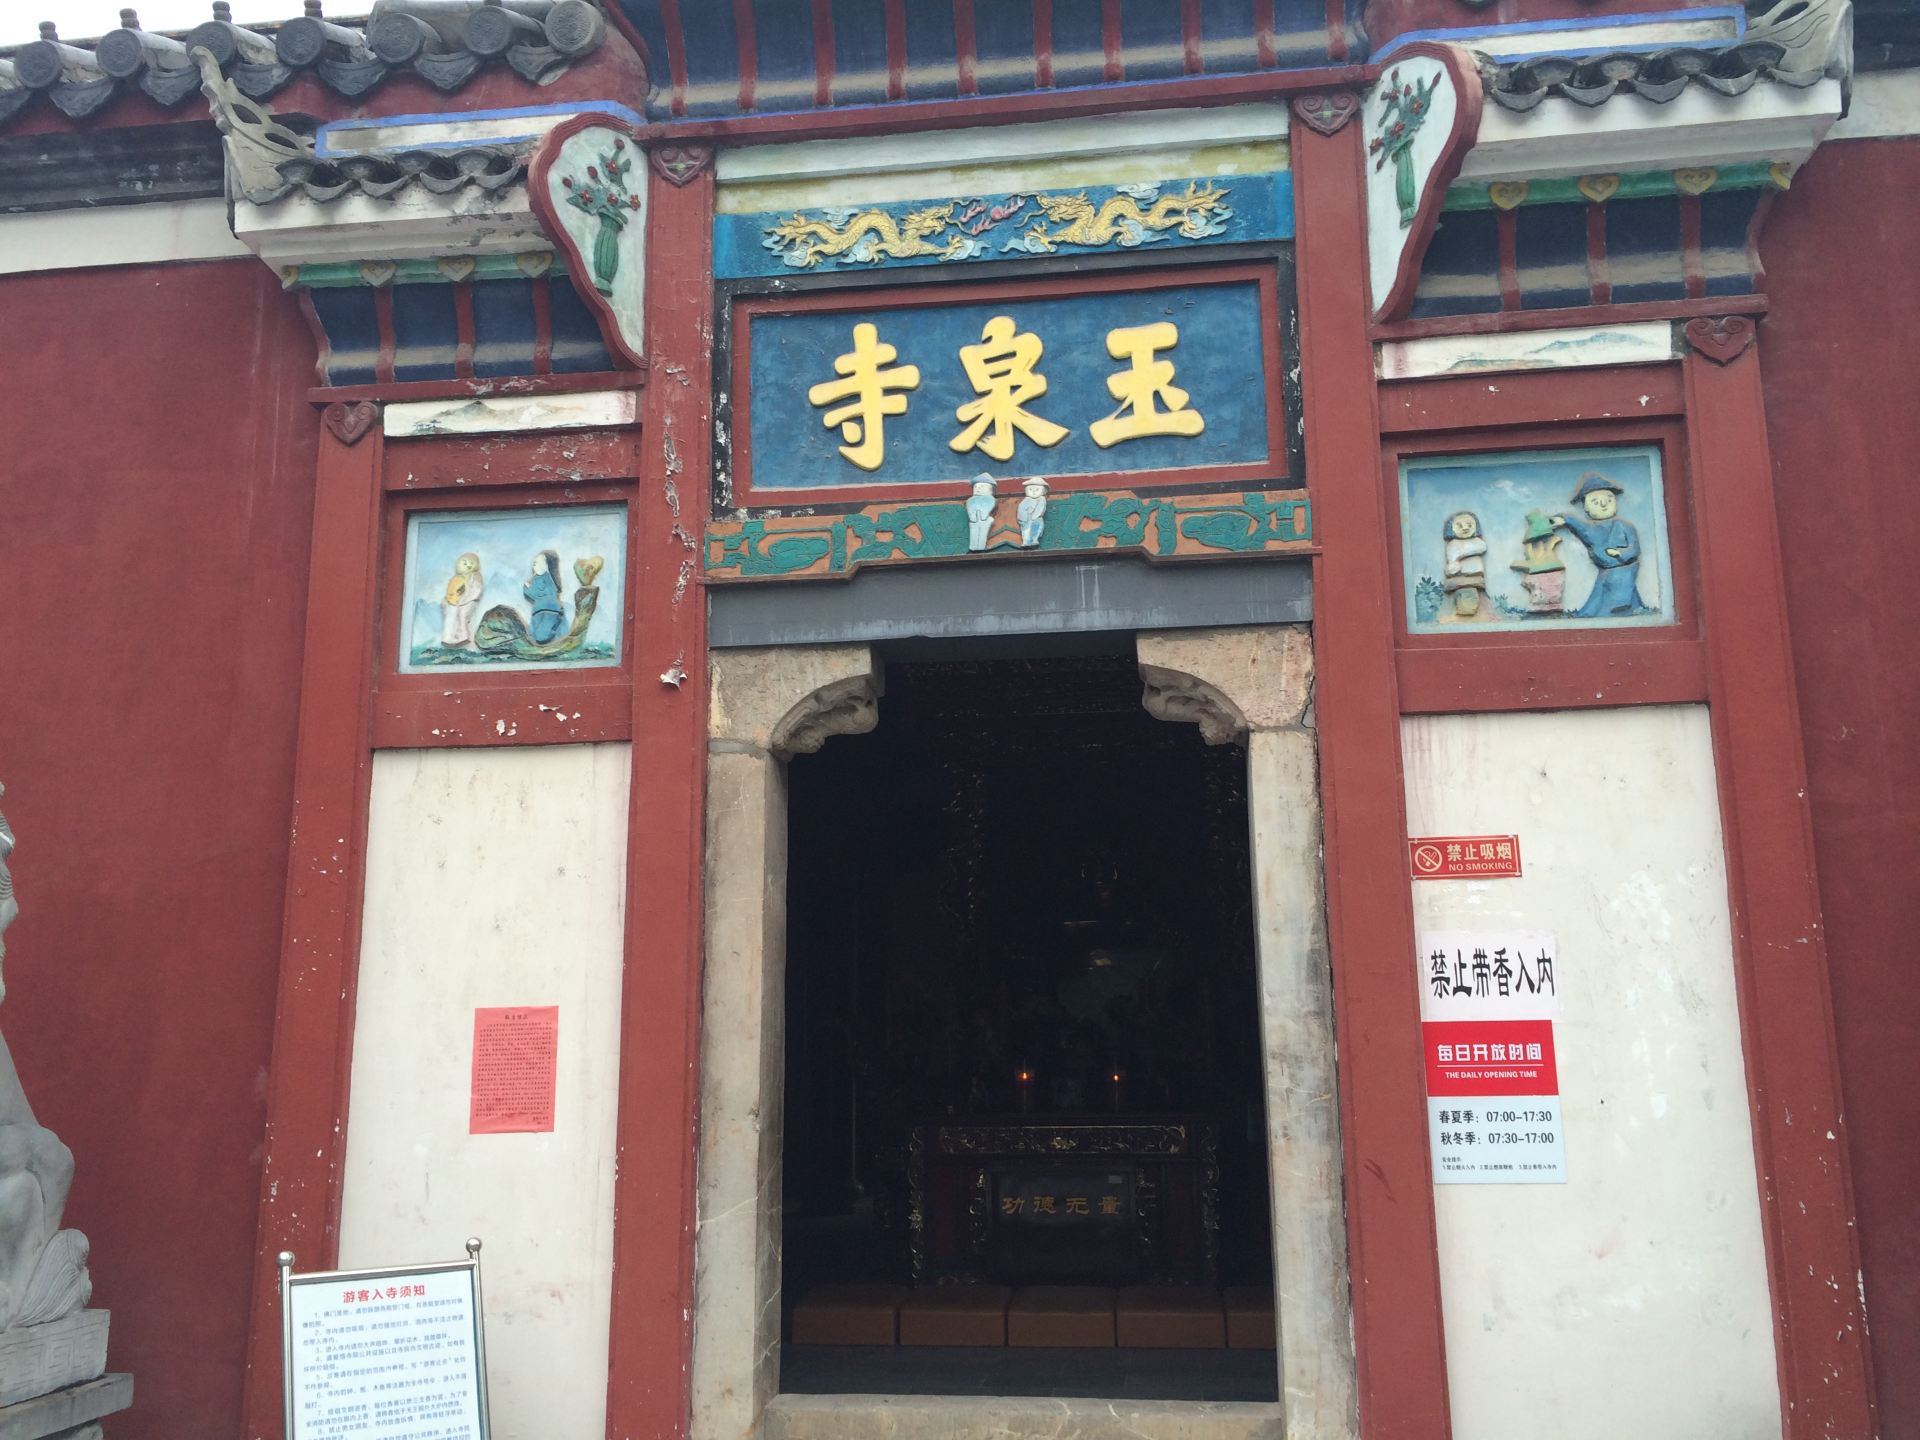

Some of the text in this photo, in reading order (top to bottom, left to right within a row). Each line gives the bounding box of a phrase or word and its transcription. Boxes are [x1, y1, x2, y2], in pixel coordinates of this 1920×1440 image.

[1447, 842, 1513, 862] 禁止吸烟
[1449, 861, 1513, 872] NO SMOKING
[1430, 947, 1555, 999] 禁止带香入内
[1437, 1043, 1542, 1062] 每日开放时间
[1445, 1071, 1460, 1079] THE
[1461, 1071, 1483, 1079] DAILY
[1486, 1111, 1553, 1122] 07:00-17:30
[1488, 1132, 1555, 1144] 07:30-17:00
[343, 1284, 426, 1303] 游客入寺须知
